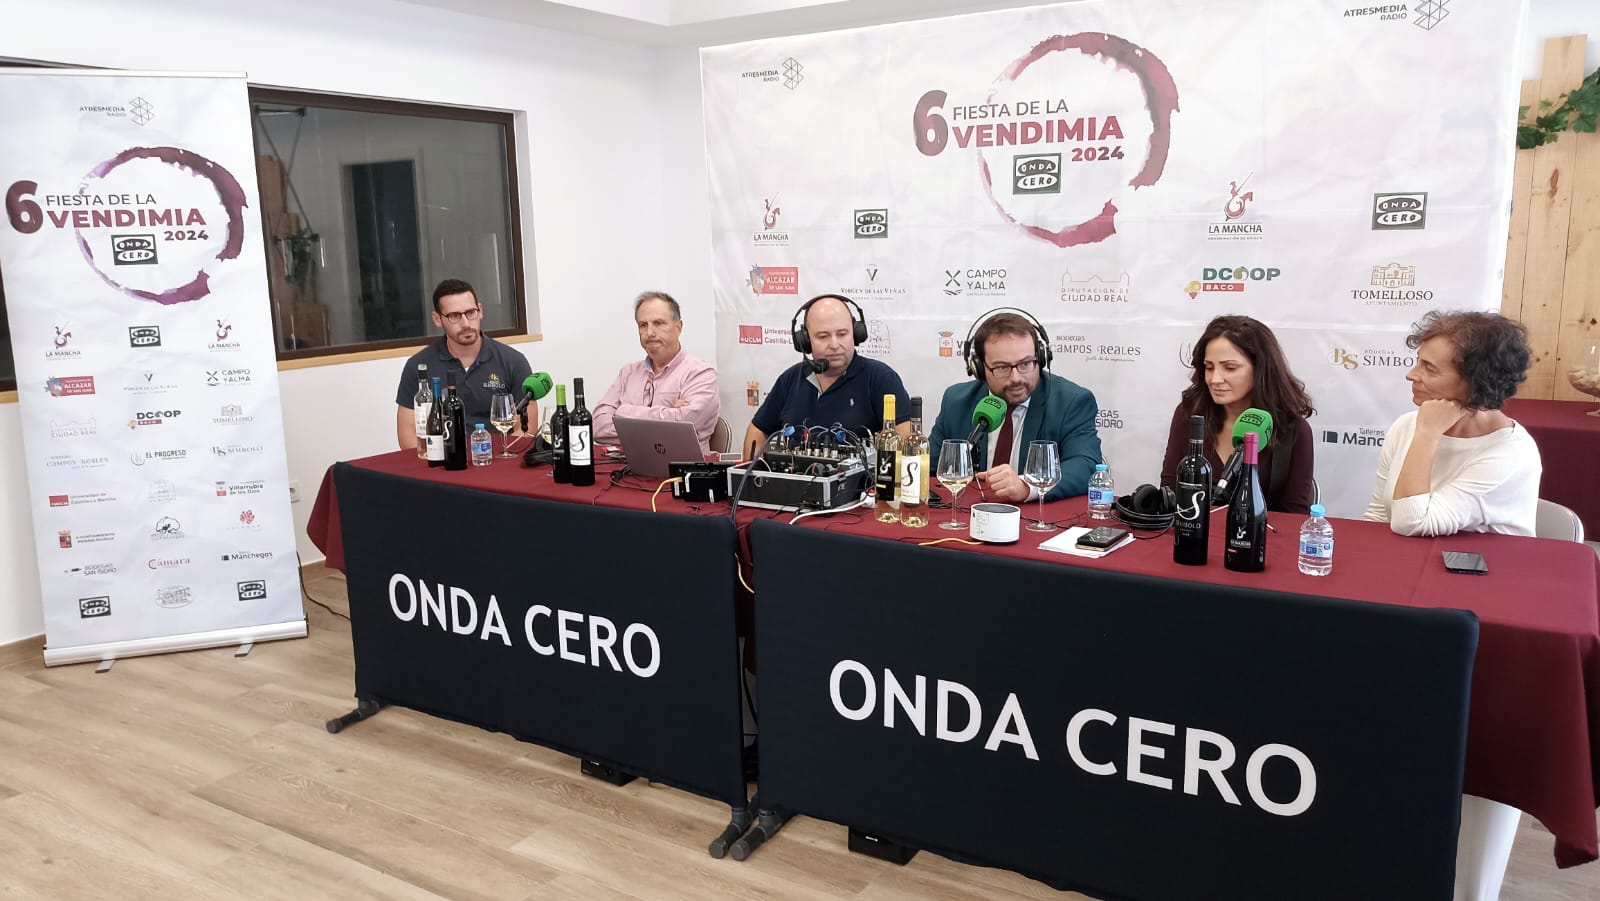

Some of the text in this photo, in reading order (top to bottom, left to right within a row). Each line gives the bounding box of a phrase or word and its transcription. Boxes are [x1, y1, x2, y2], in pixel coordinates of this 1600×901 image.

[1343, 3, 1408, 17] ATRESMEDIA
[1380, 12, 1408, 21] RADIO
[953, 98, 1069, 121] FIESTA DE LA
[912, 89, 949, 157] 6
[952, 115, 1124, 149] VENDIMIA
[1071, 145, 1125, 162] 2024
[1021, 163, 1053, 173] ONDA
[1023, 176, 1053, 187] CERO
[46, 193, 157, 206] FIESTA DE LA
[5, 180, 43, 234] 6
[1382, 201, 1417, 210] ONDA
[46, 208, 206, 228] VENDIMIA
[859, 215, 882, 223] ONDA
[1383, 213, 1416, 222] CERO
[861, 225, 882, 233] CERO
[1208, 224, 1263, 233] LA MANCHA
[164, 229, 209, 241] 2024
[762, 233, 789, 242] MANCHA
[119, 240, 150, 250] ONDA
[122, 251, 151, 260] CERO
[966, 269, 1007, 279] CAMPO
[966, 280, 1006, 290] YALMA
[1061, 294, 1129, 303] CIUDAD REAL
[1351, 289, 1433, 300] TOMELLOSO
[764, 337, 794, 345] Castilla-L
[1362, 354, 1415, 367] SIMBO
[1095, 418, 1123, 429] SIDRO
[1342, 431, 1385, 447] Manc
[389, 573, 661, 678] ONDA CERO
[829, 659, 1317, 816] ONDA CERO
